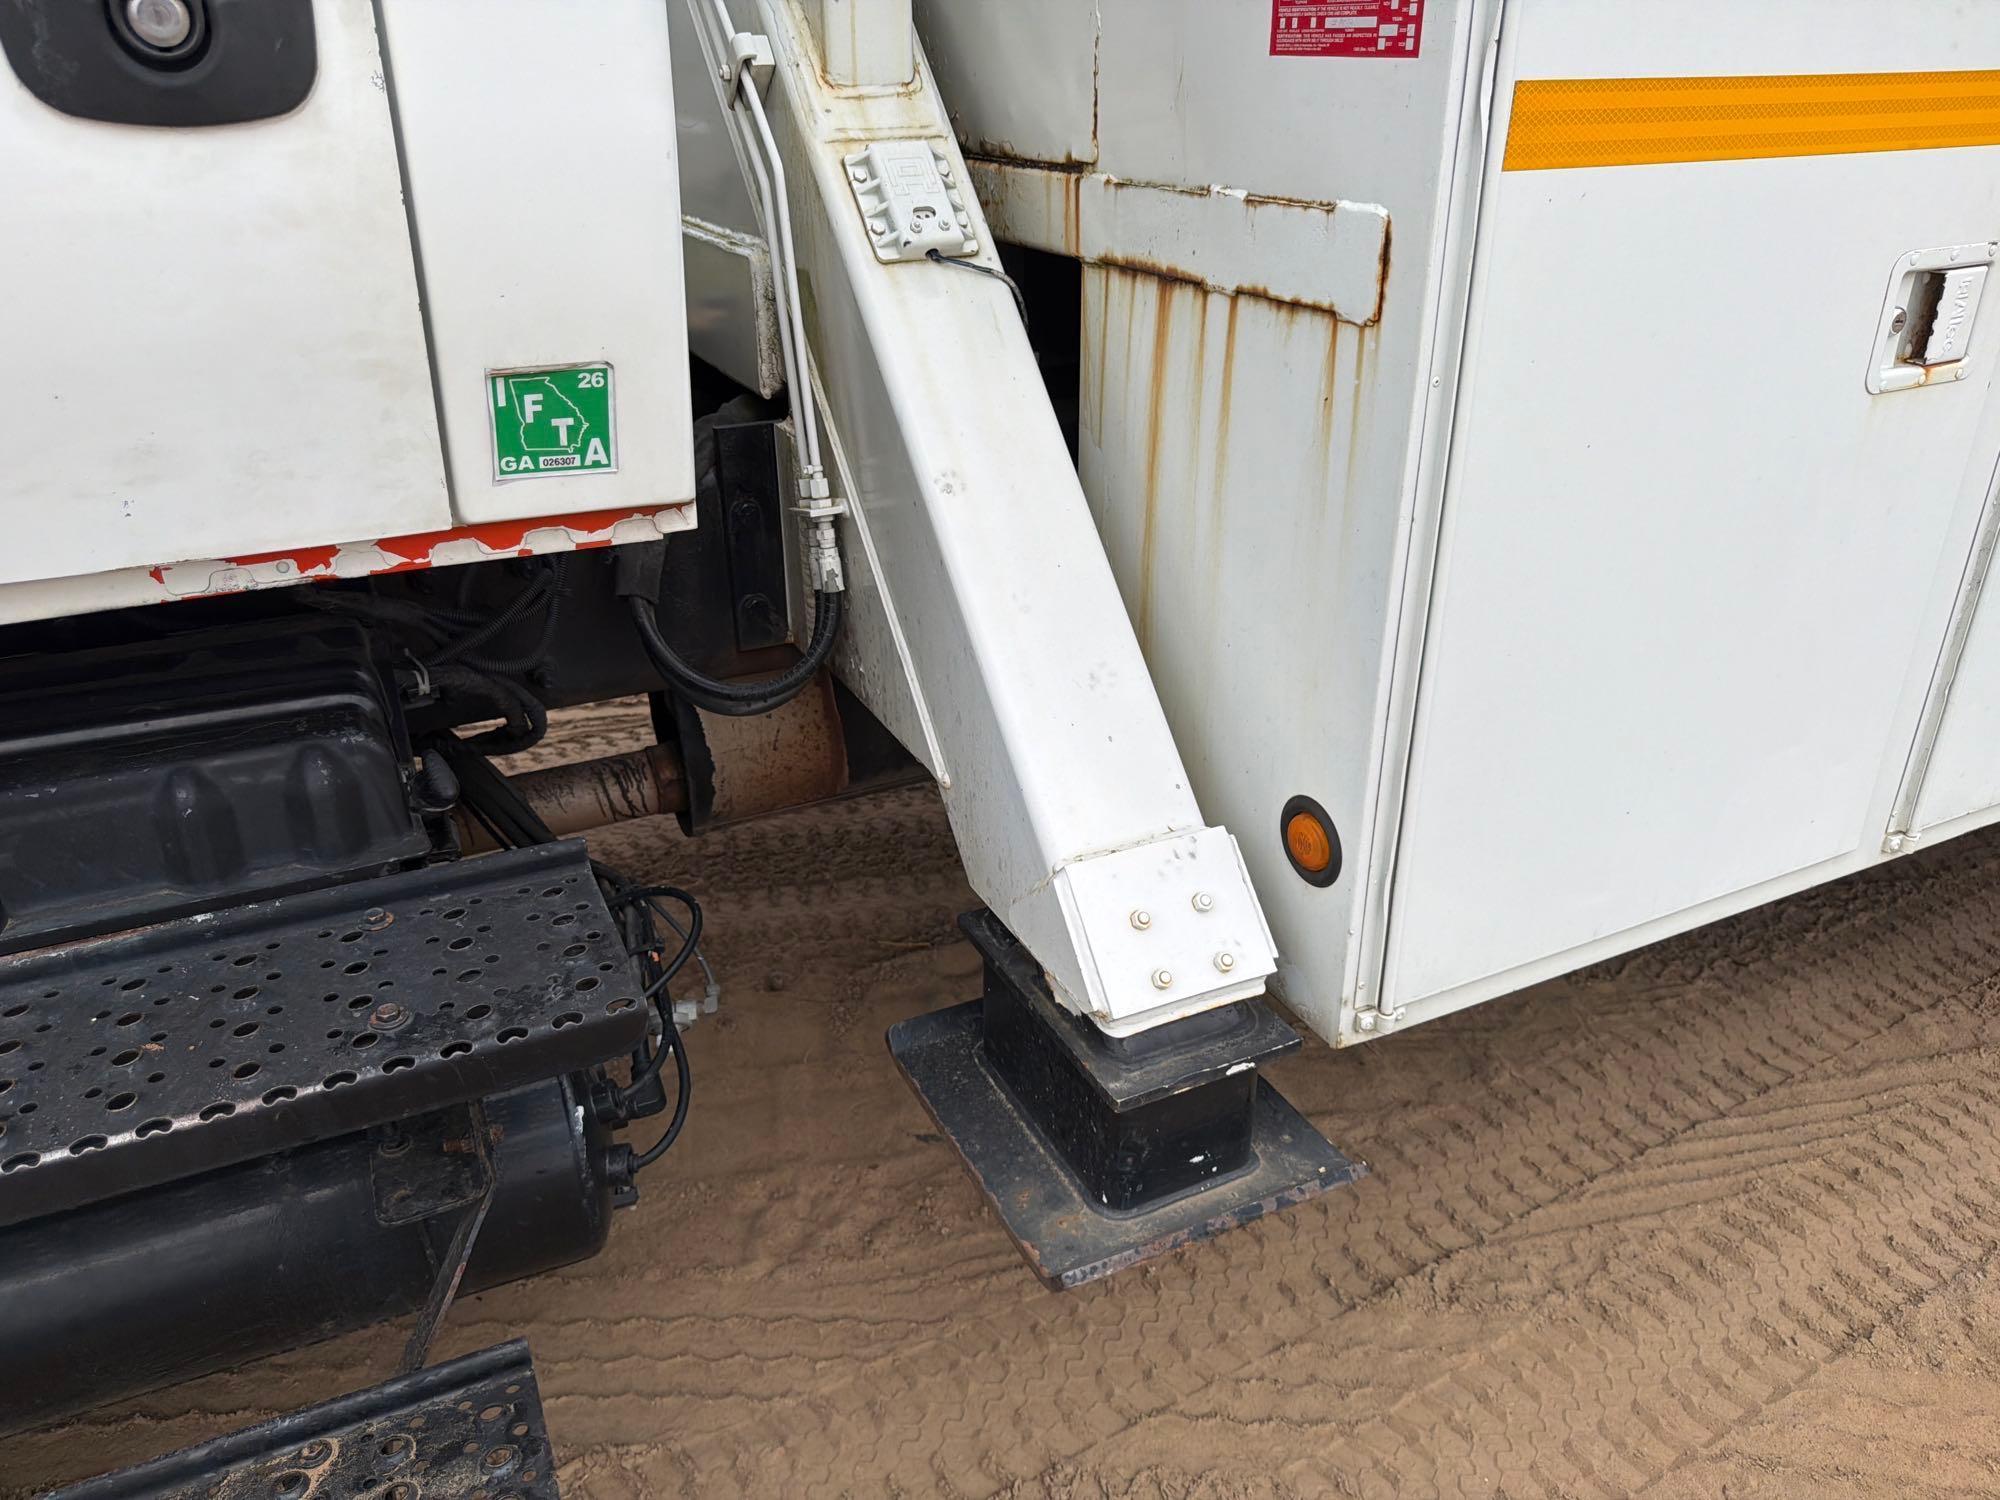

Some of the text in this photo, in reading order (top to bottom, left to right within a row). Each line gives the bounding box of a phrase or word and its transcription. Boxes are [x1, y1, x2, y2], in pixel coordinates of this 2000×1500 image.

[578, 372, 605, 388] 26
[500, 455, 576, 471] GA 026307
